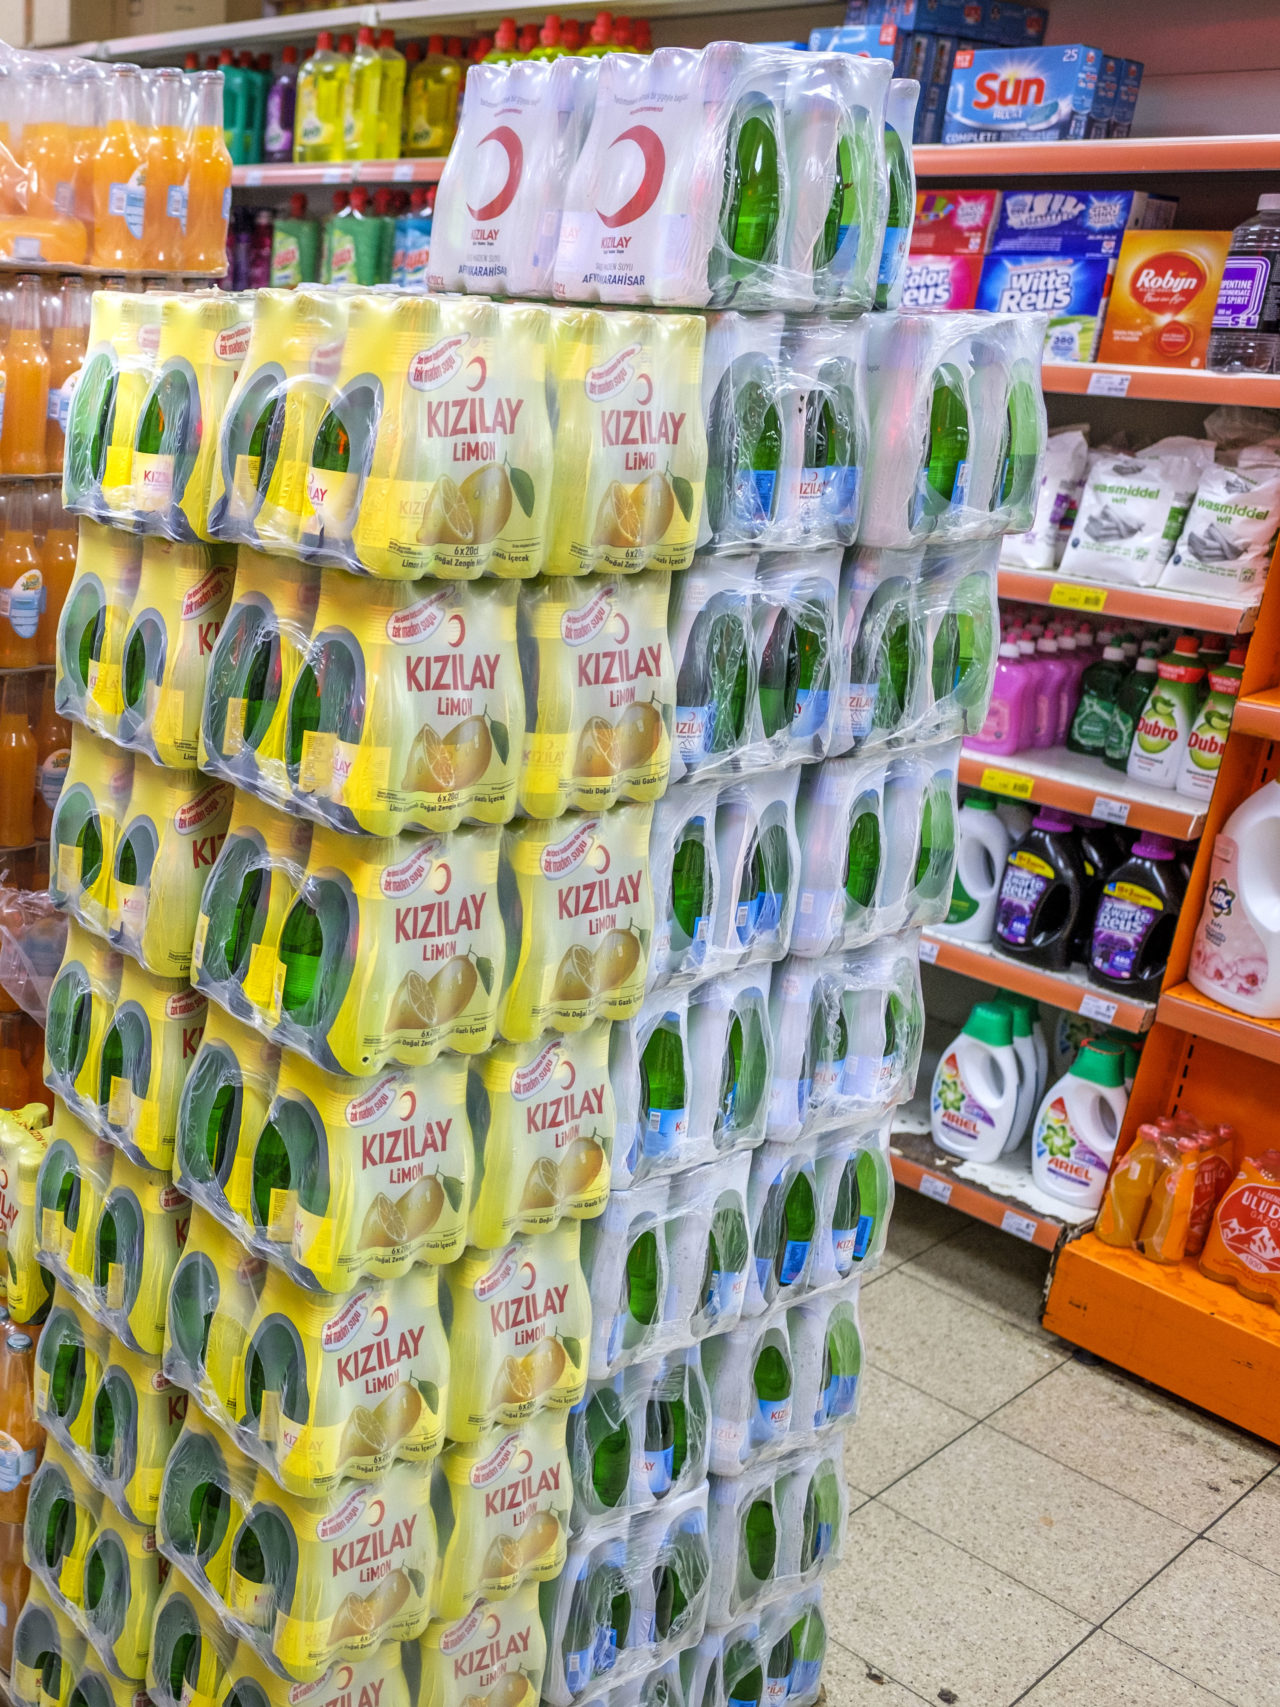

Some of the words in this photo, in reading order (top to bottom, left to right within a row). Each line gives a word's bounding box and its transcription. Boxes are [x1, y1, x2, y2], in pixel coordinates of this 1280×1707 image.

[1062, 49, 1079, 62] 25
[972, 72, 1046, 110] Sun
[902, 285, 951, 306] eus
[1011, 269, 1071, 292] Witte
[1136, 268, 1198, 294] Robijn
[999, 287, 1071, 312] Reus
[427, 397, 524, 438] KIZILAY
[601, 409, 687, 448] KIZILAY
[1112, 495, 1128, 506] wit
[1197, 497, 1270, 521] wasmiddel
[1216, 514, 1233, 526] wit
[406, 653, 500, 692] KIZILAY
[577, 643, 662, 687] KIZILAY
[1137, 715, 1179, 742] Dubro
[558, 870, 643, 920] KIZILAY
[395, 891, 487, 944] KIZILAY
[1099, 913, 1144, 934] Reus
[1104, 902, 1151, 924] Zwarte
[527, 1084, 605, 1134] KIZILAY
[942, 1109, 980, 1134] ARIEL
[361, 1118, 453, 1171] KIZILAY
[1048, 1157, 1093, 1182] ARIEL
[1241, 1190, 1280, 1219] ULUD
[490, 1284, 569, 1337] KIZILAY
[337, 1325, 425, 1388] KIZILAY
[485, 1462, 561, 1517] KIZILAY
[332, 1514, 417, 1577] KIZILAY
[454, 1625, 531, 1680] KIZILAY
